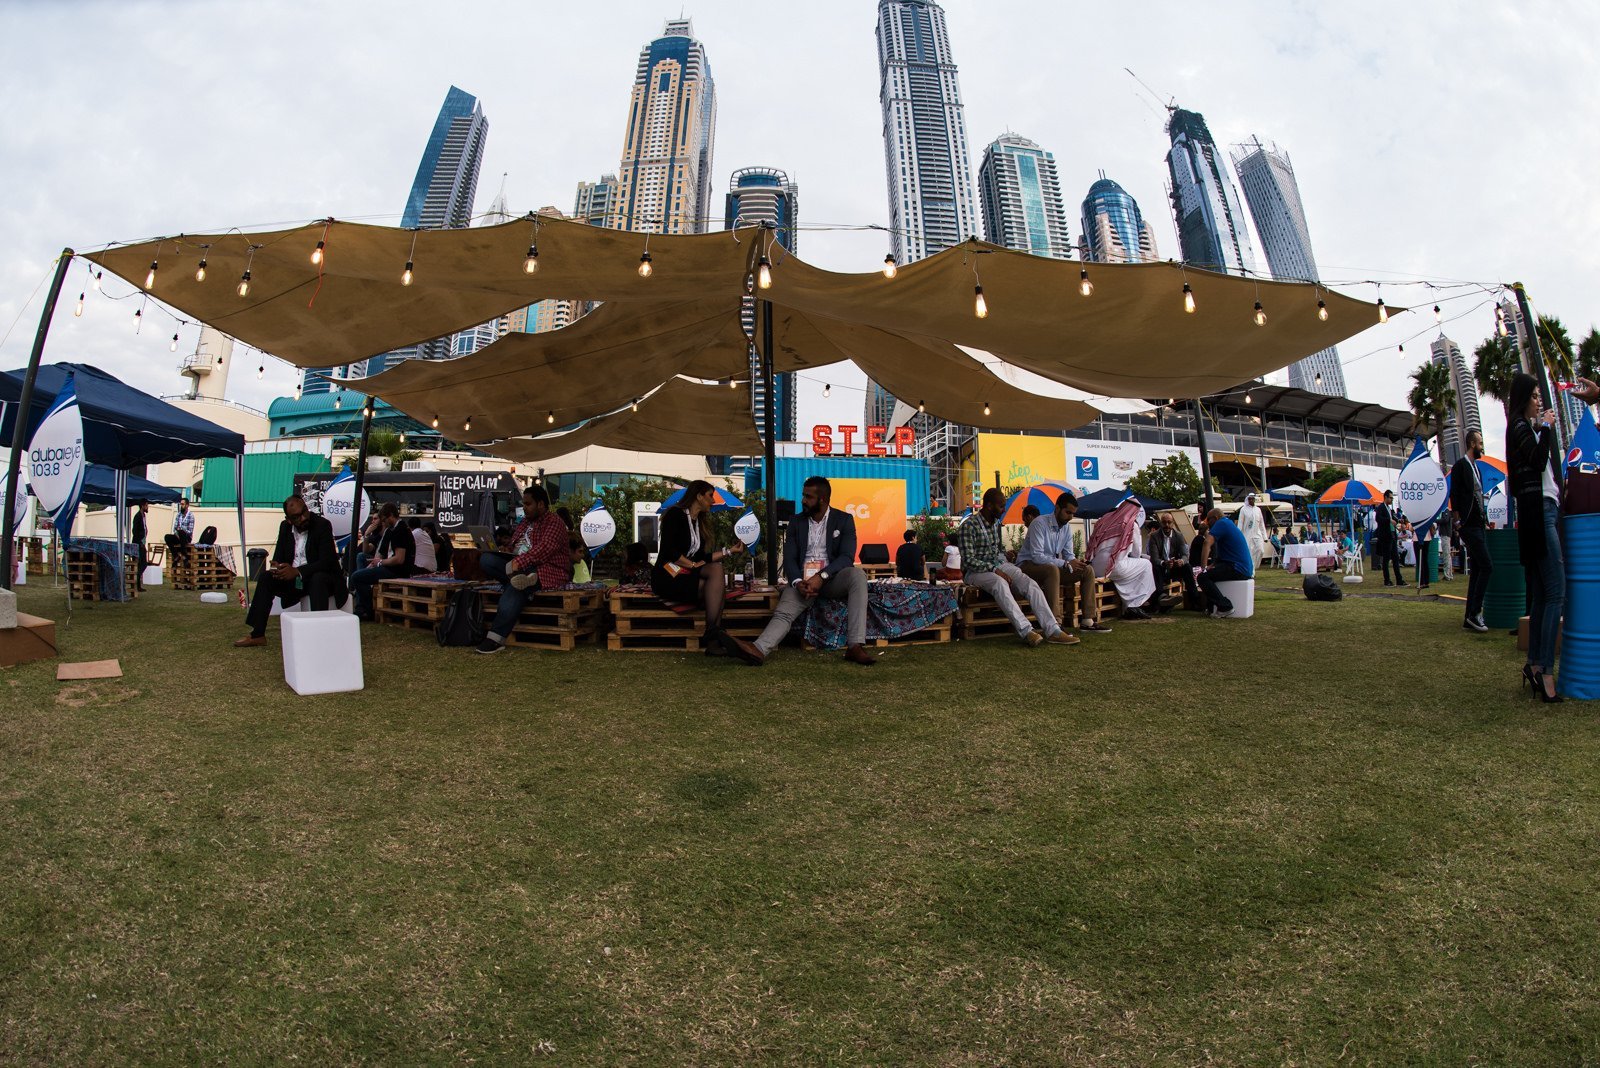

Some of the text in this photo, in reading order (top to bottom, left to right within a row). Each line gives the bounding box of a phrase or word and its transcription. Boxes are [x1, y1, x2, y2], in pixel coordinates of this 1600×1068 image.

[813, 425, 915, 455] STEP
[32, 463, 60, 477] 103.8
[1008, 460, 1031, 485] step
[440, 475, 498, 490] KEEP CALM
[439, 491, 452, 509] AND
[1401, 491, 1423, 501] 103.8
[327, 506, 347, 515] 103.8
